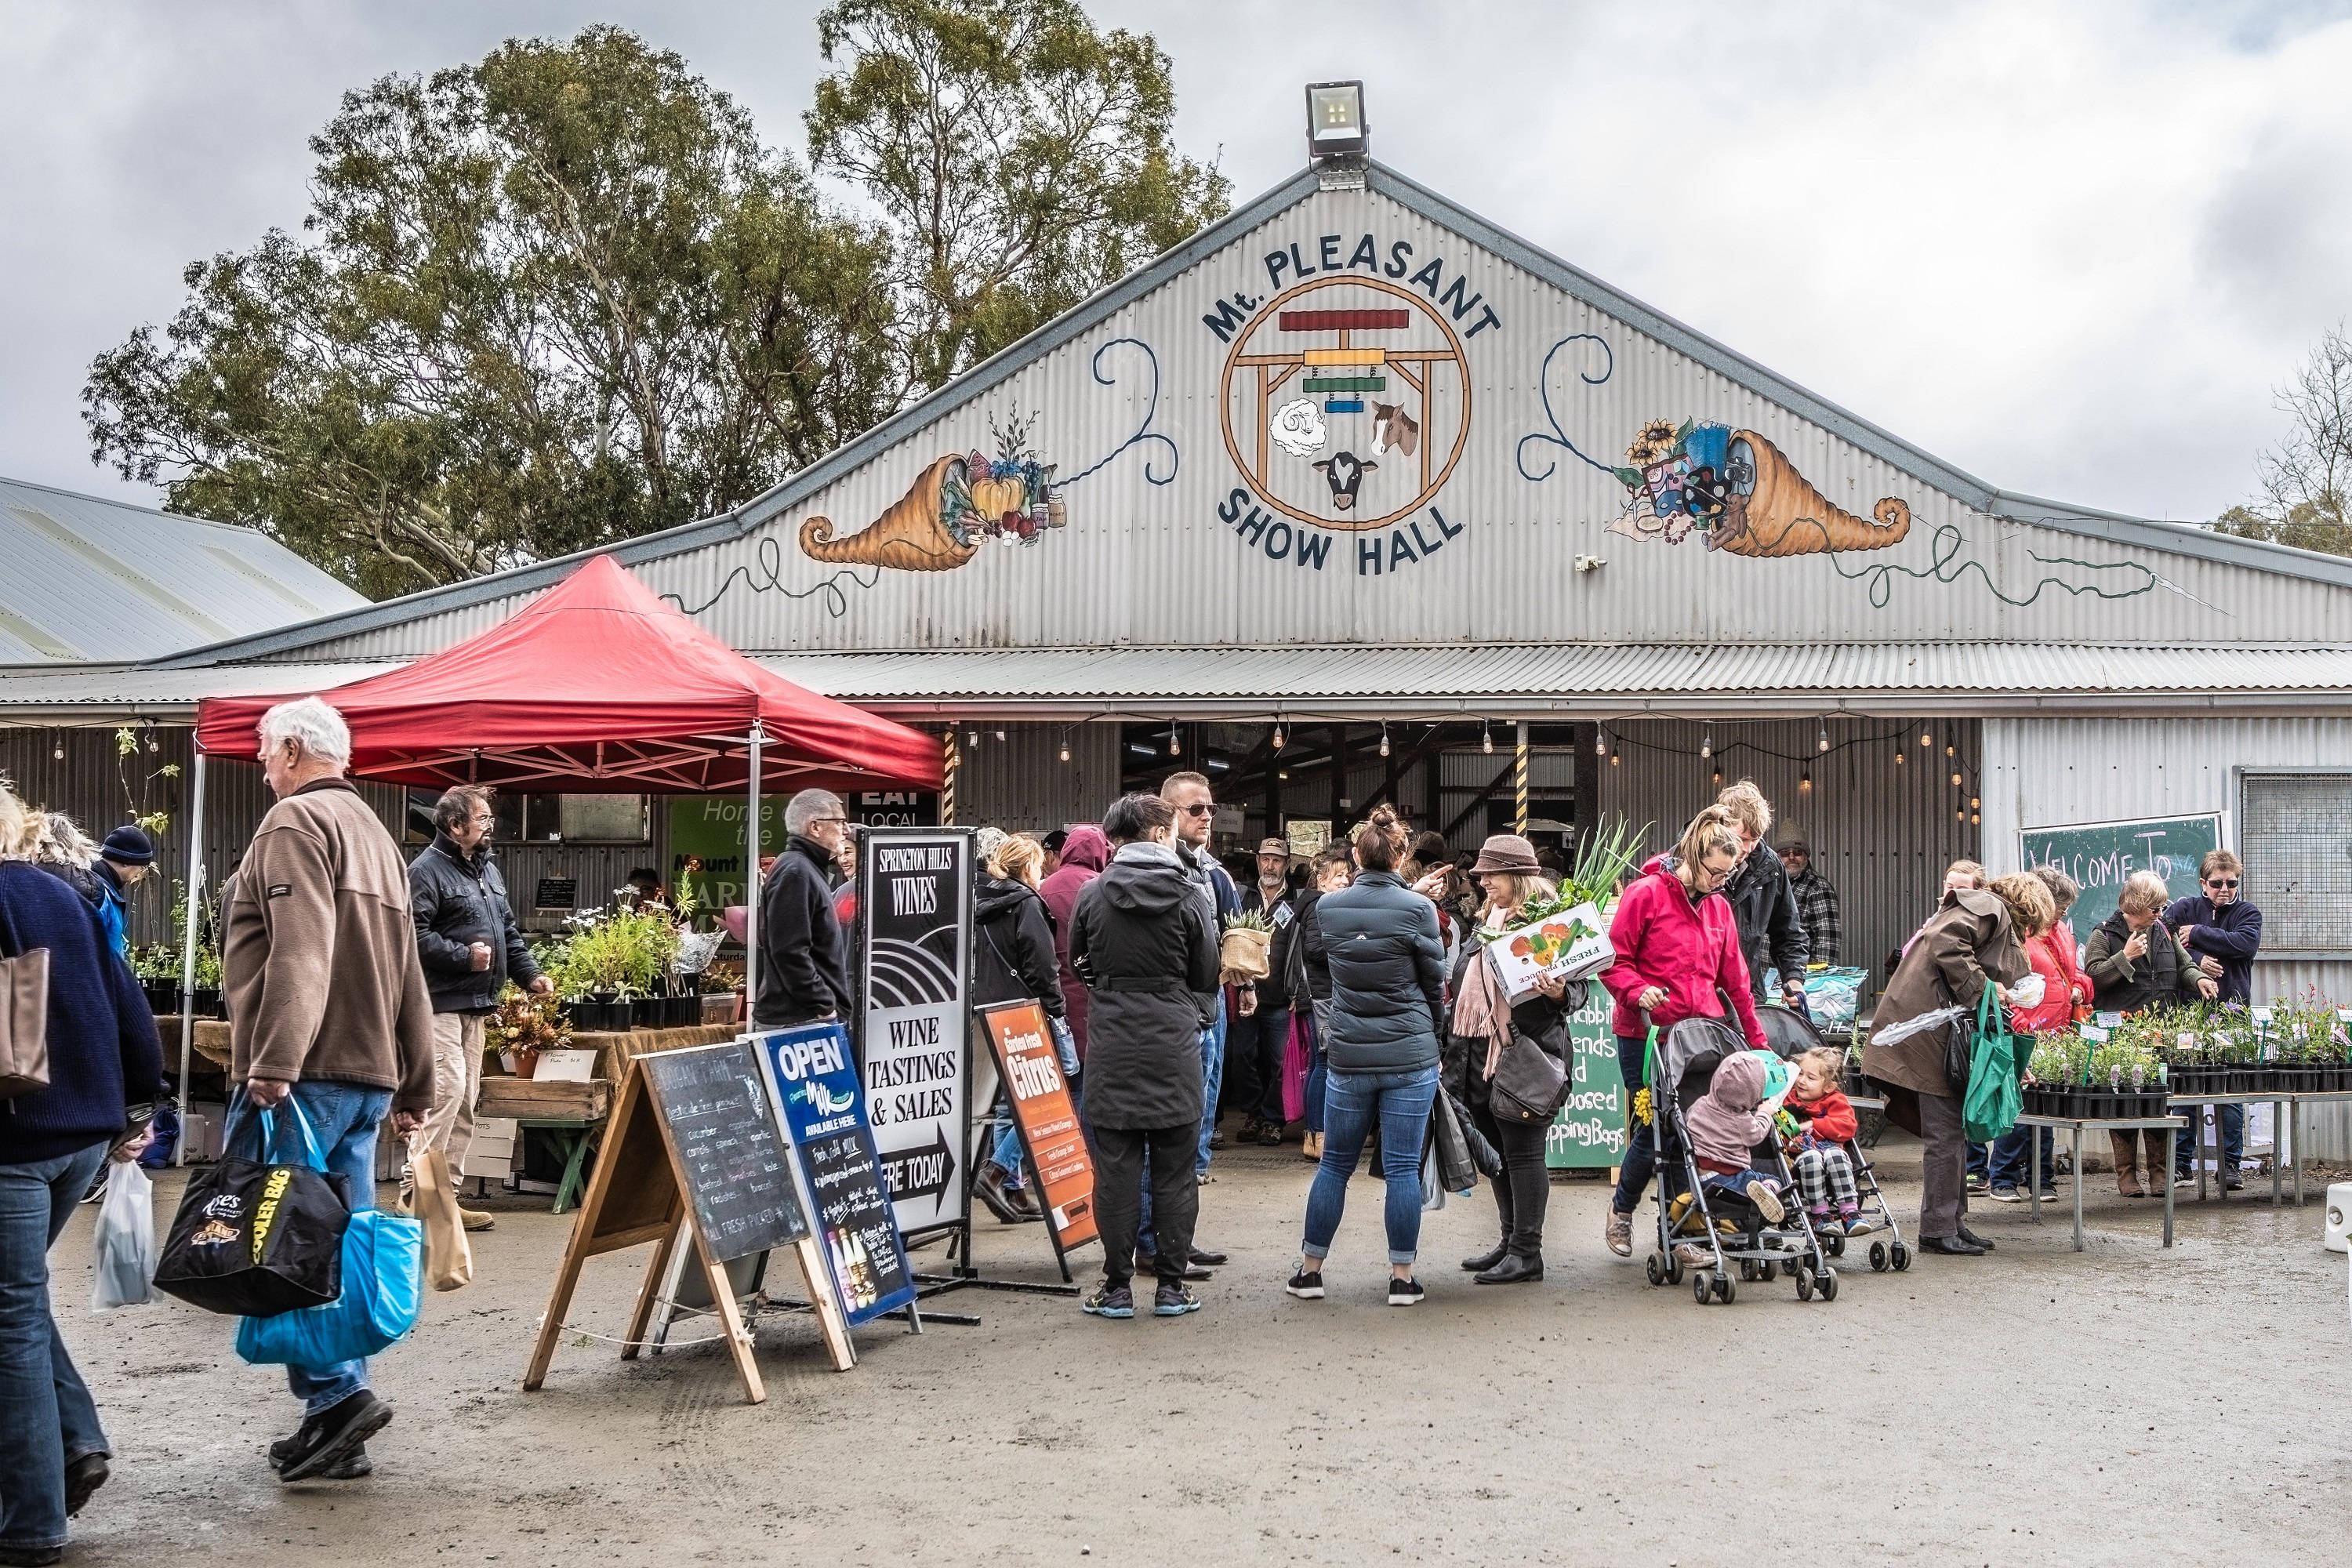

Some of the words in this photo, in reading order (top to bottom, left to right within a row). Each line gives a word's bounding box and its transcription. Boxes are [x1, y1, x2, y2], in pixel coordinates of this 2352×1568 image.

[1202, 292, 1265, 344] Mt.
[1264, 234, 1502, 339] PLEASANT
[1218, 488, 1333, 571] SHOW
[1358, 505, 1464, 576] HALL
[736, 824, 772, 845] te
[879, 848, 927, 873] SPRINGTON
[927, 847, 952, 870] HILLS
[891, 876, 936, 916] WINES
[1561, 946, 1599, 967] FRESH
[889, 1017, 939, 1049] WINE
[779, 1036, 845, 1080] OPEN
[868, 1051, 956, 1090] TASTINGS
[1006, 1054, 1061, 1100] Citrus
[871, 1098, 887, 1126] &
[895, 1087, 952, 1123] SALES
[1565, 1083, 1617, 1121] posed
[805, 1119, 840, 1137] AVAILABLE
[839, 1114, 857, 1128] HERE
[1546, 1119, 1592, 1154] pping
[263, 1170, 291, 1199] BAG
[881, 1160, 903, 1192] RE
[906, 1152, 945, 1190] TODAY
[252, 1200, 278, 1265] COOLER
